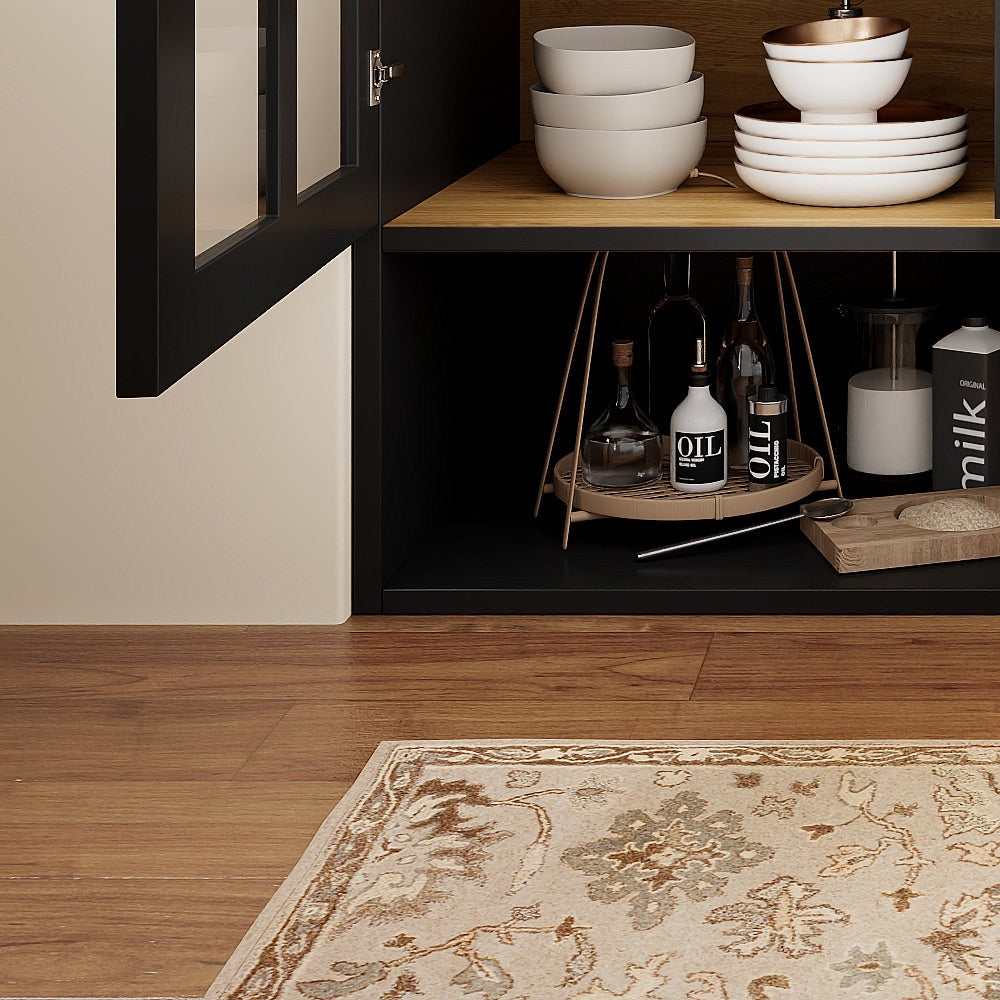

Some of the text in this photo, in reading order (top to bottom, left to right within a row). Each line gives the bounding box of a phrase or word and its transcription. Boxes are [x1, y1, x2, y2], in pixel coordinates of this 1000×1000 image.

[959, 379, 986, 390] ORIGINAL
[677, 435, 722, 458] OIL
[749, 421, 771, 479] OIL
